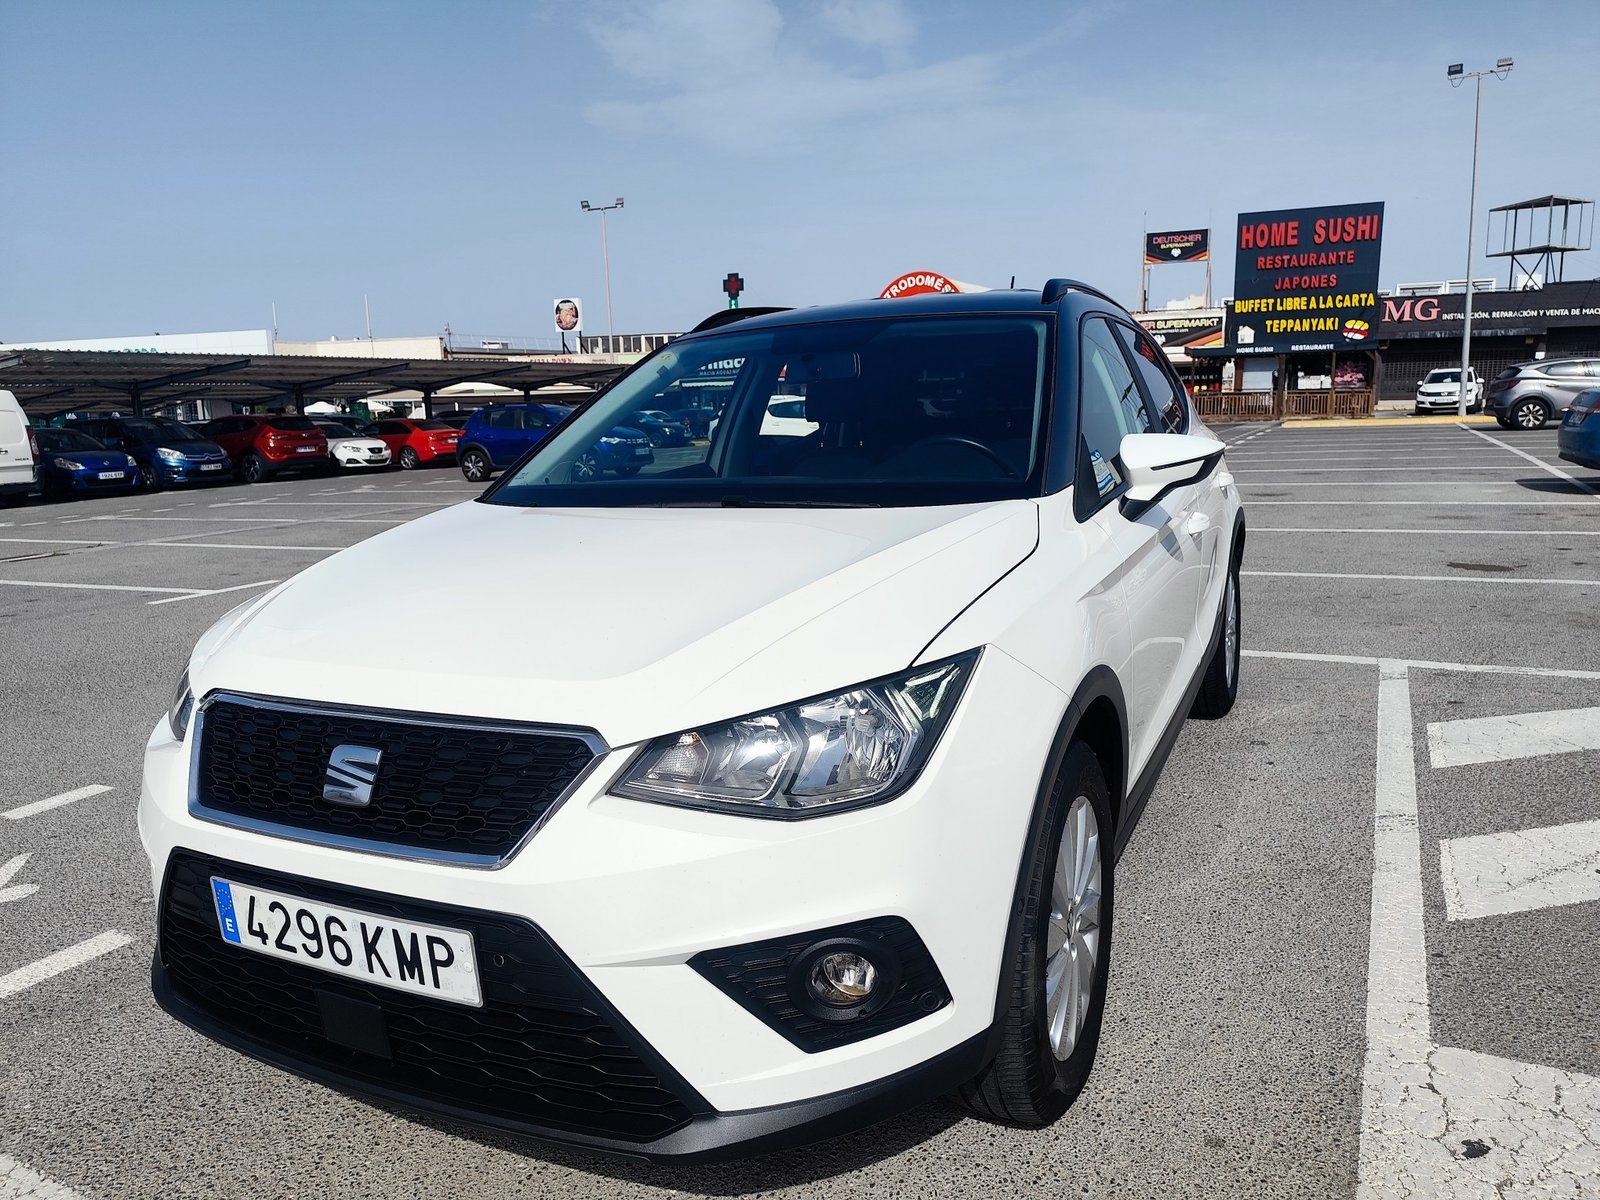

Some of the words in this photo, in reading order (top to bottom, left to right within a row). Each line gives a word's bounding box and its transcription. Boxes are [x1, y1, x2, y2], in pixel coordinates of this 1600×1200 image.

[1153, 234, 1202, 244] DEUTSCHER
[1240, 221, 1299, 249] HOME
[1313, 214, 1379, 244] SUSHI
[1257, 251, 1355, 270] RESTAURANTE
[1274, 274, 1337, 290] JAPONES
[1234, 298, 1274, 313] BUFFET
[1276, 296, 1307, 311] LIBRE
[1309, 296, 1317, 310] A
[1319, 295, 1334, 309] LA
[1335, 293, 1375, 308] CARTA
[1381, 298, 1441, 322] MG
[1491, 309, 1538, 318] REPARACIÓN
[1539, 309, 1545, 317] Y
[1545, 308, 1569, 317] VENTA
[1156, 318, 1219, 329] SUPERMARKT
[1265, 317, 1339, 333] TEPPANYAKI
[1236, 346, 1254, 354] HOME
[1290, 343, 1335, 351] RESTAURANTE
[225, 918, 235, 932] E
[247, 895, 353, 967] 4296
[359, 922, 455, 989] KMP
